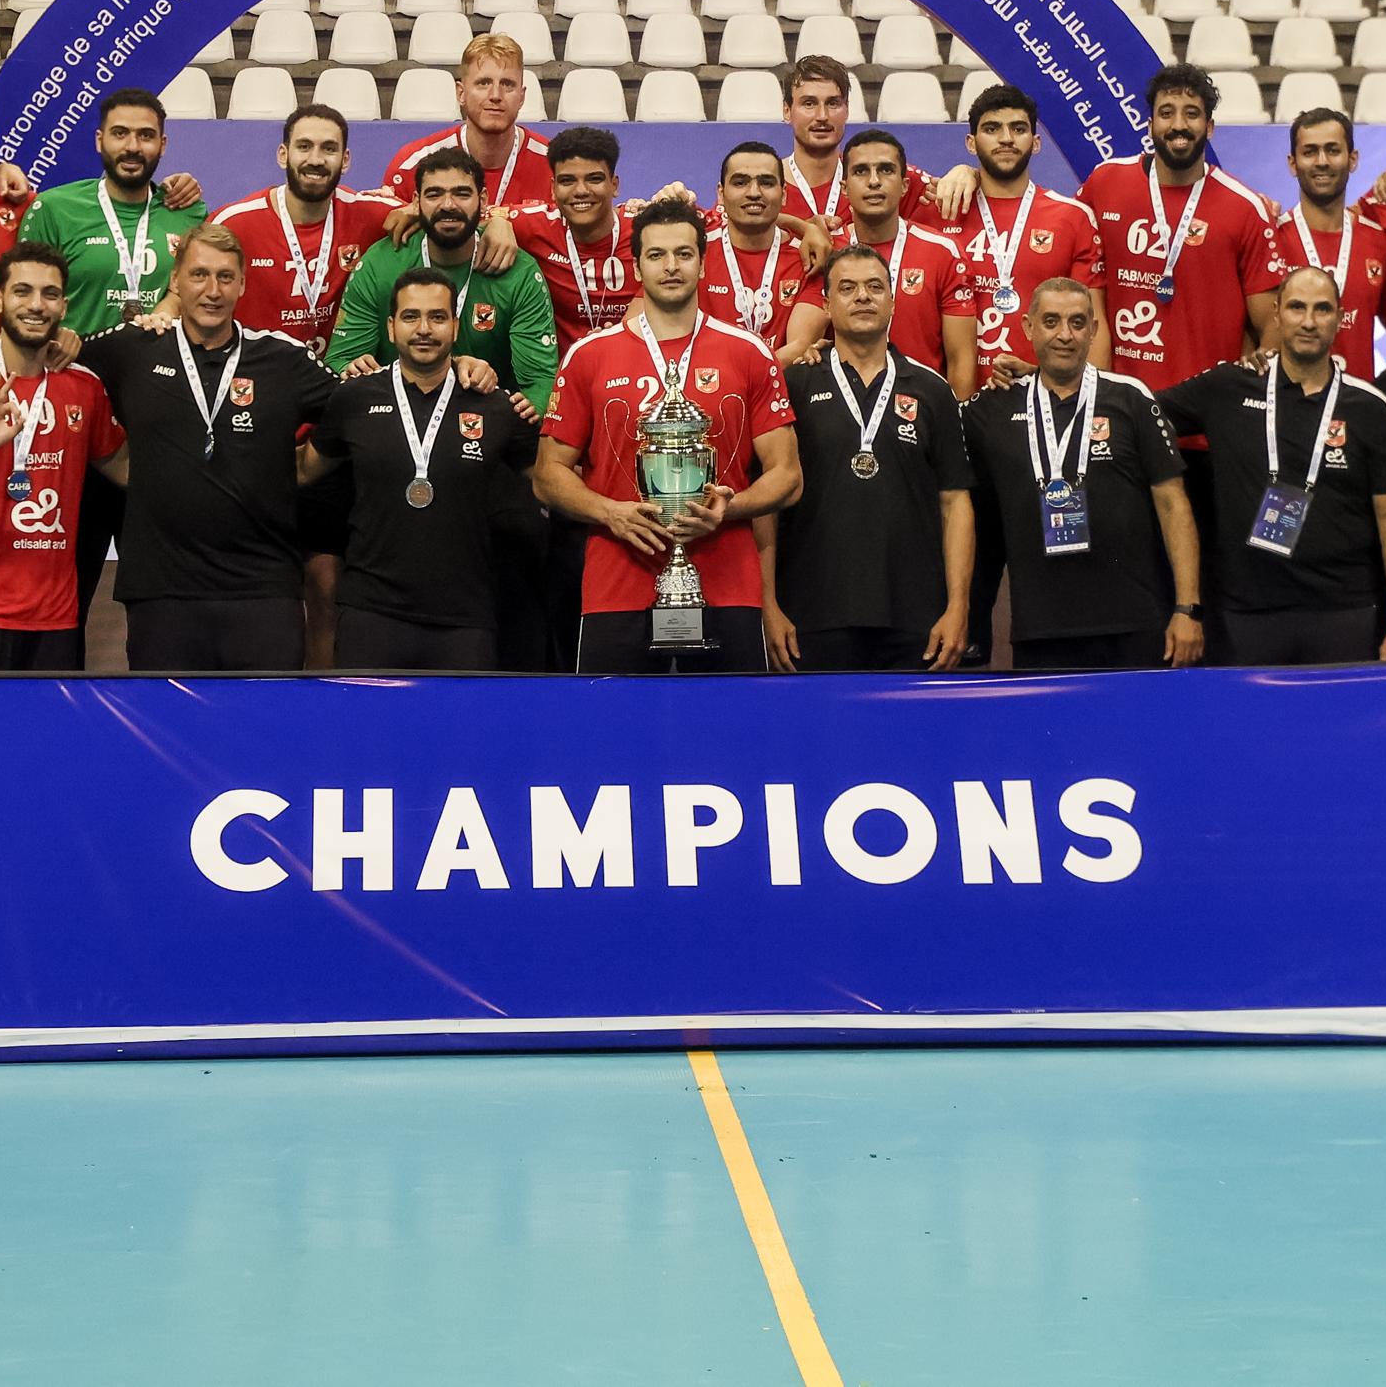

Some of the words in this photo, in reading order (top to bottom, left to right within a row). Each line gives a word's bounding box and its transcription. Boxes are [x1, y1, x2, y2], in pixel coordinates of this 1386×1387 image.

[63, 36, 91, 67] de
[87, 7, 115, 37] sa
[1048, 0, 1105, 61] الجلالة
[27, 81, 101, 192] mpionnat
[96, 0, 173, 83] d'afrique
[1074, 100, 1114, 162] طولة
[86, 236, 110, 245] JAKO
[1126, 218, 1172, 260] 62
[114, 238, 158, 276] 16
[250, 258, 275, 268] JAKO
[285, 257, 330, 297] 72
[582, 256, 625, 292] 10
[106, 288, 161, 303] FABISR
[707, 284, 729, 294] JAKO
[1142, 351, 1164, 363] and
[153, 364, 177, 377] JAKO
[605, 376, 630, 389] JAKO
[809, 391, 833, 404] JAKO
[1242, 397, 1267, 410] JAKO
[368, 405, 394, 414] JAKO
[12, 538, 51, 549] etisalat
[190, 778, 1142, 893] CHAMPIONS
